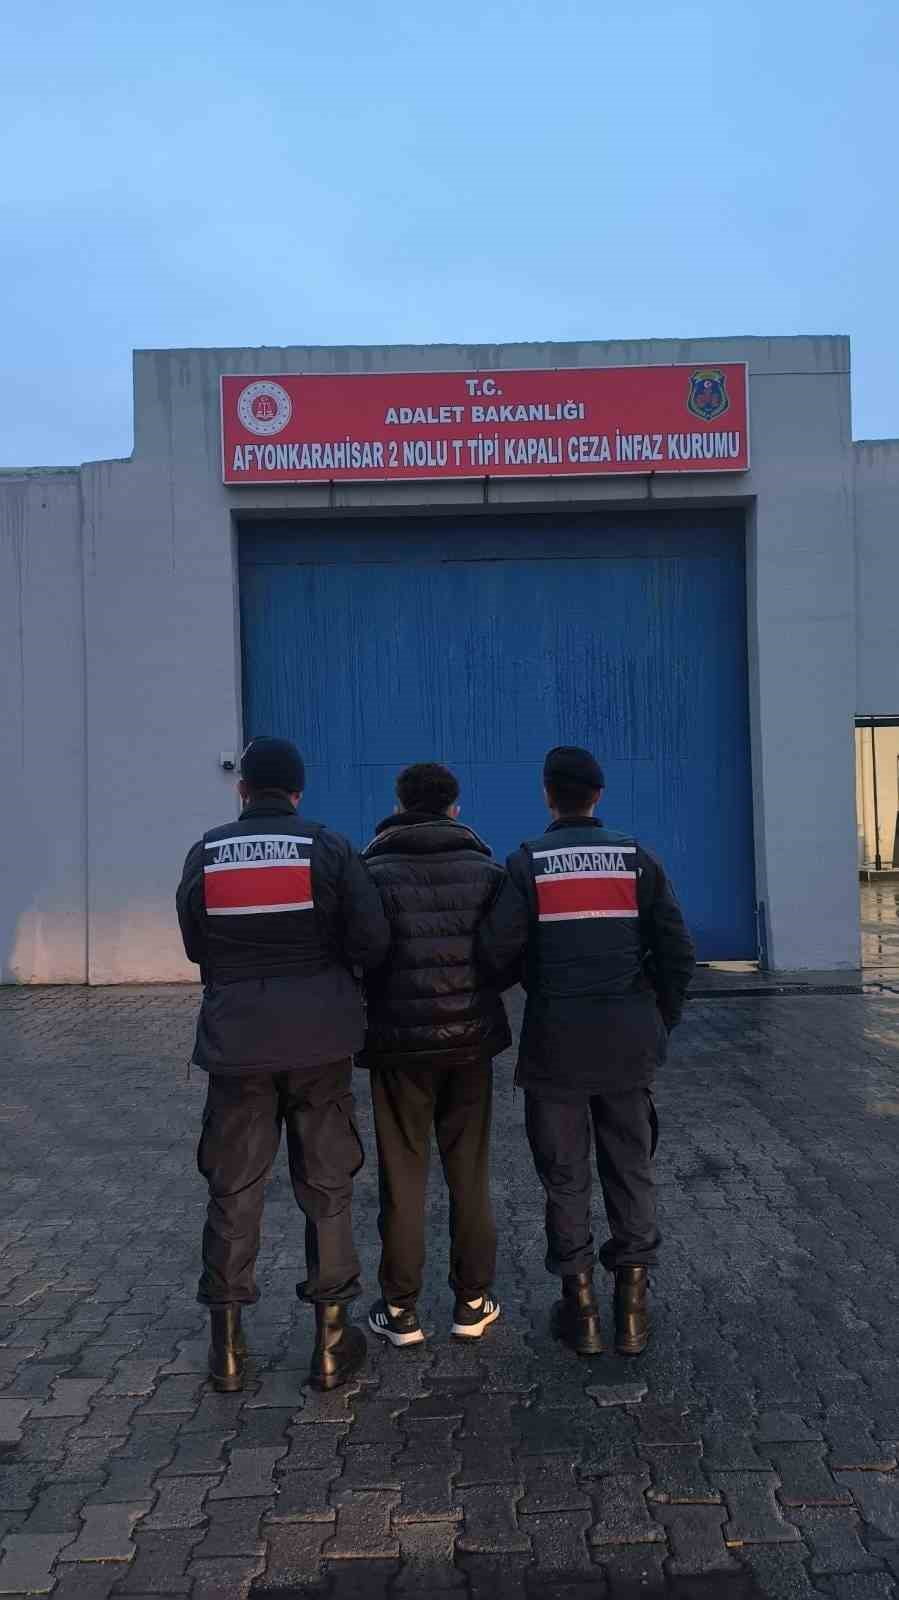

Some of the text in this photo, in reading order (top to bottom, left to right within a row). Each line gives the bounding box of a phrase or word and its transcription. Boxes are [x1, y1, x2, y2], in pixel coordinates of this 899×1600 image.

[465, 379, 503, 396] T.C.
[384, 400, 585, 425] ADALET BAKANLIĞI
[232, 428, 740, 471] AFYONKARAHİSAR 2 NOLU T TİPİ KAPALI CEZA İNFAZ KURUMU
[213, 841, 300, 864] JANDARMA
[543, 853, 627, 874] JANDARMA
